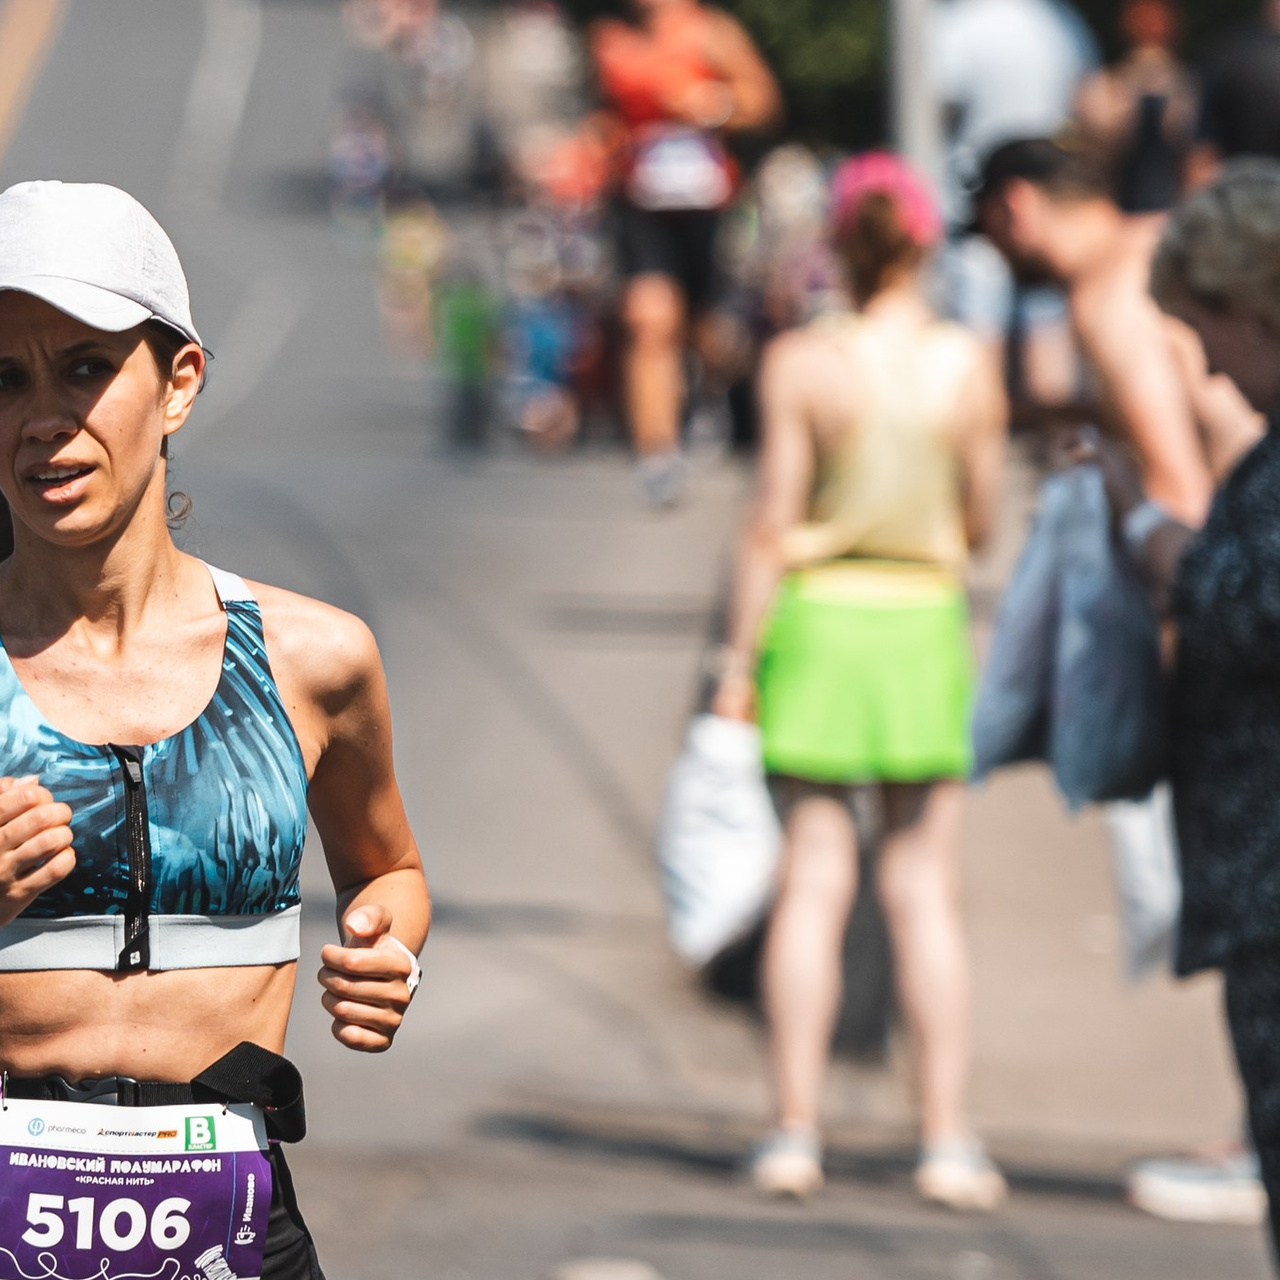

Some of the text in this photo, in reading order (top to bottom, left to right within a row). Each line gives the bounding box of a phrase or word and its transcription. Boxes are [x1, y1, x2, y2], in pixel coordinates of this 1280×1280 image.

[47, 1125, 86, 1134] pharmeco
[10, 1152, 222, 1174] ИВАНОВСКИЙ ПОЛУМАРАФОН
[75, 1176, 155, 1186] «КРАСНАЯ НИТЬ»
[243, 1173, 255, 1222] Иваново
[21, 1192, 192, 1252] 5106
